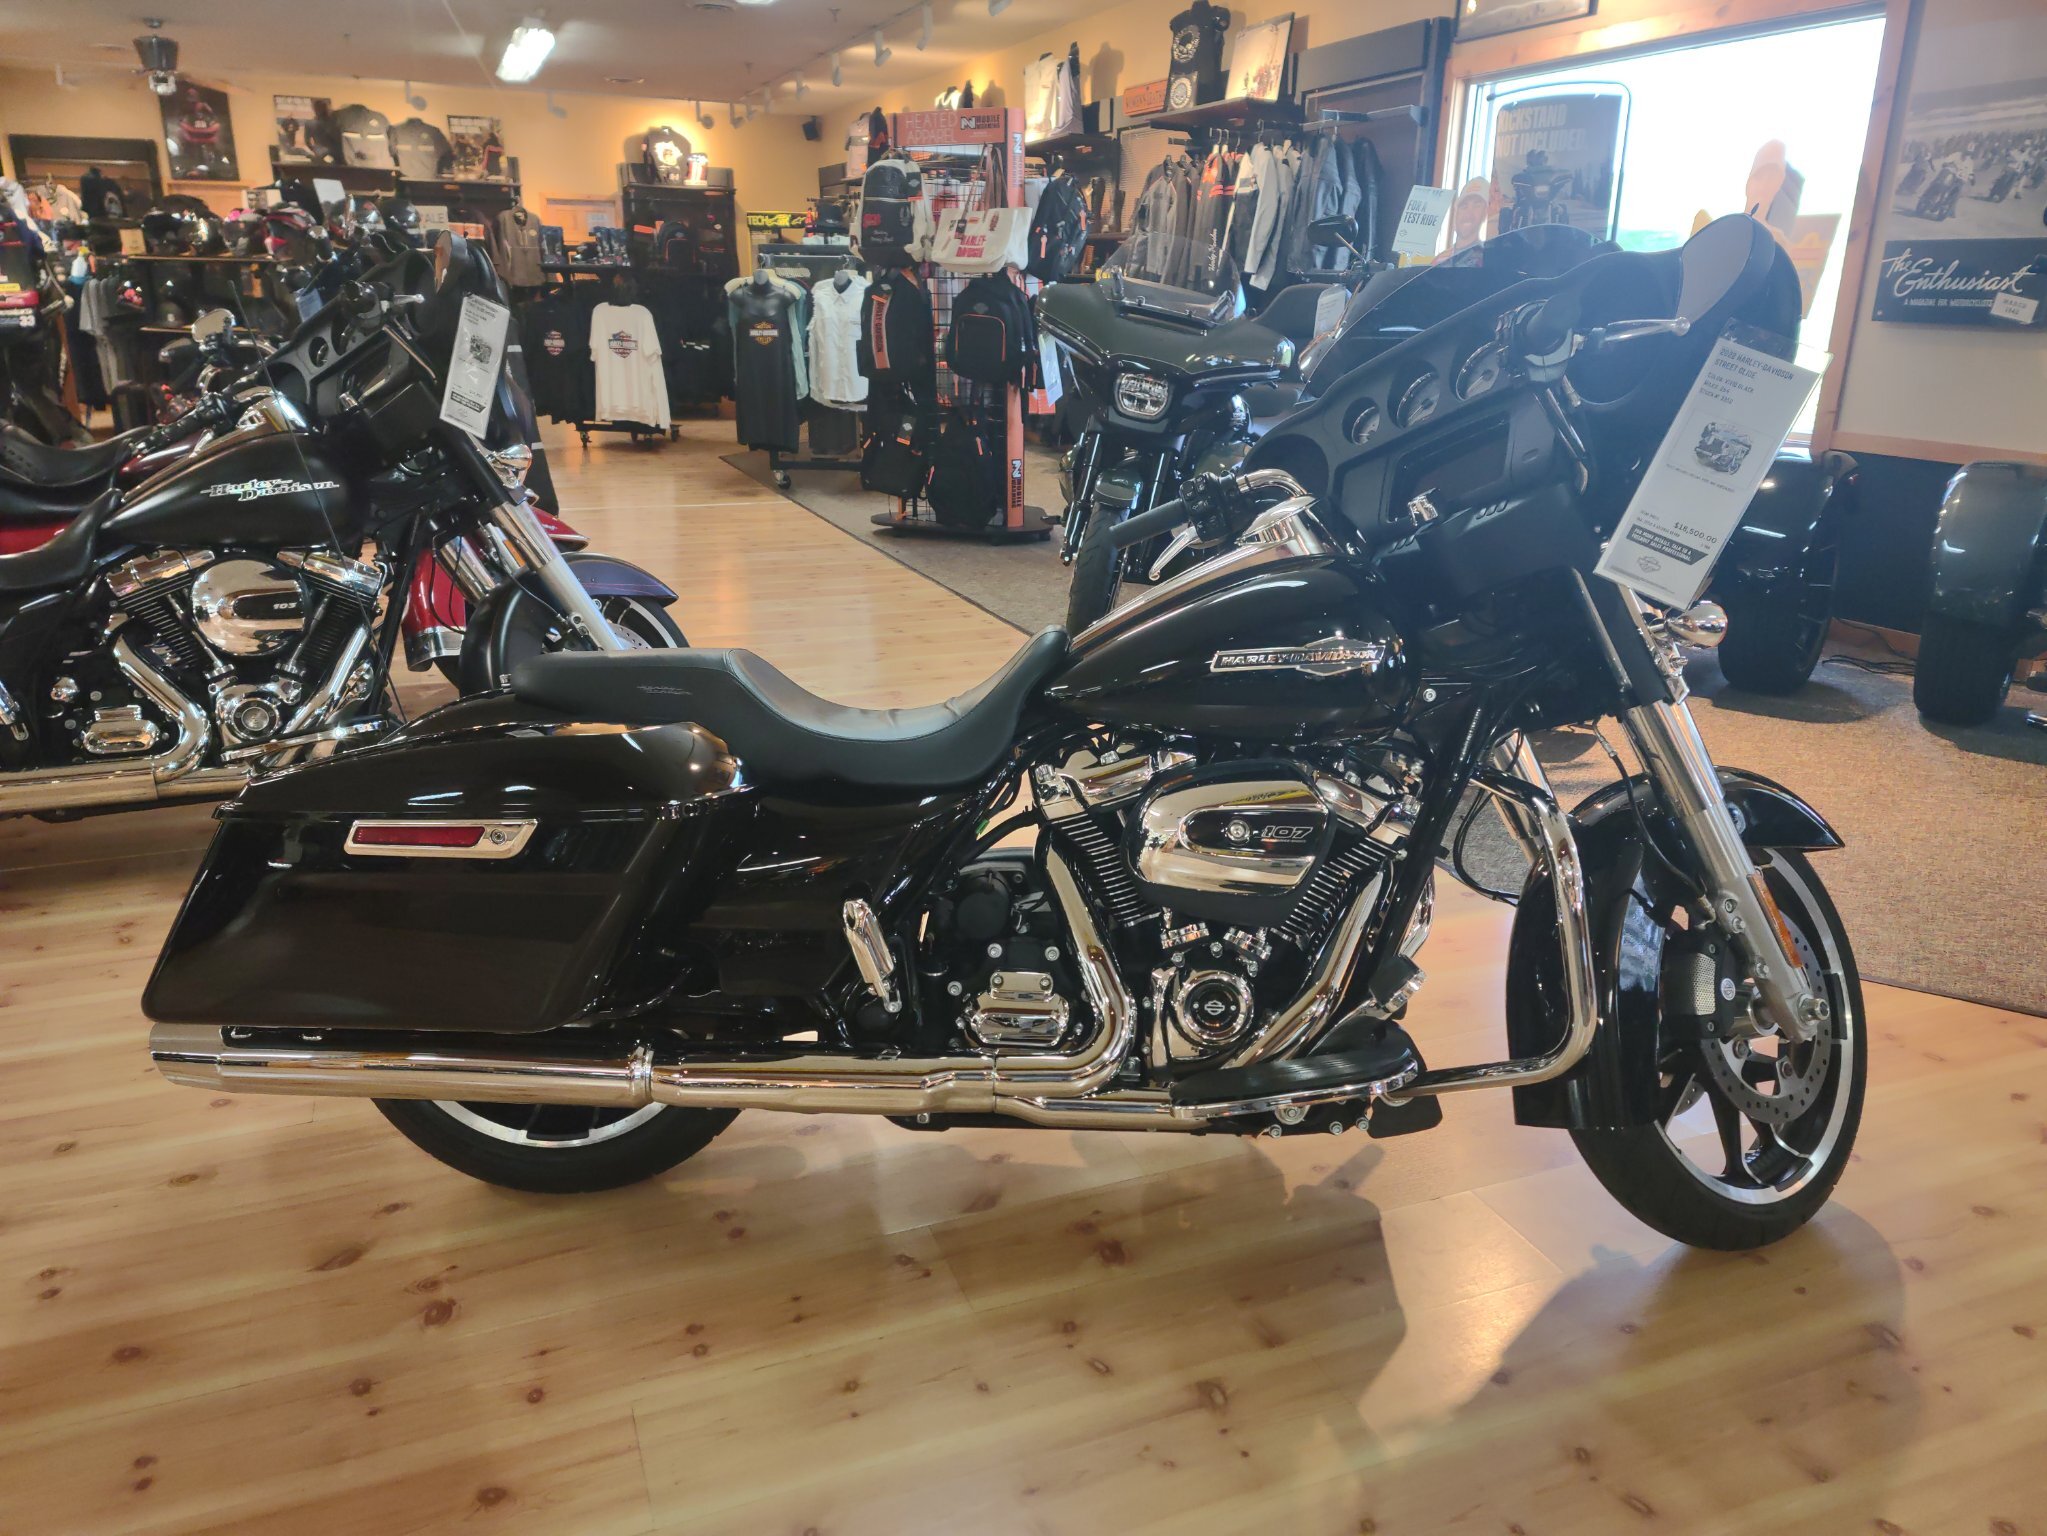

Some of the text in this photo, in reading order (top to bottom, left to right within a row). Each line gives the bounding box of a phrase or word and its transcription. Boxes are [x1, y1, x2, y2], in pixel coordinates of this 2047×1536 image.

[906, 112, 957, 128] HEATED
[907, 127, 957, 143] APPAREL
[1408, 200, 1421, 211] FOR
[1404, 212, 1438, 226] TEST RIDE
[1882, 248, 2037, 297] The Enthusiast
[1714, 359, 1758, 379] STREET GLIDE
[1720, 348, 1795, 380] 2022 HARLEY-DAVIDSON
[238, 481, 340, 501] Davidson
[1674, 521, 1717, 544] $18,500.00
[1221, 649, 1378, 666] HARLEY-DAVIDSON
[1261, 825, 1314, 839] 107
